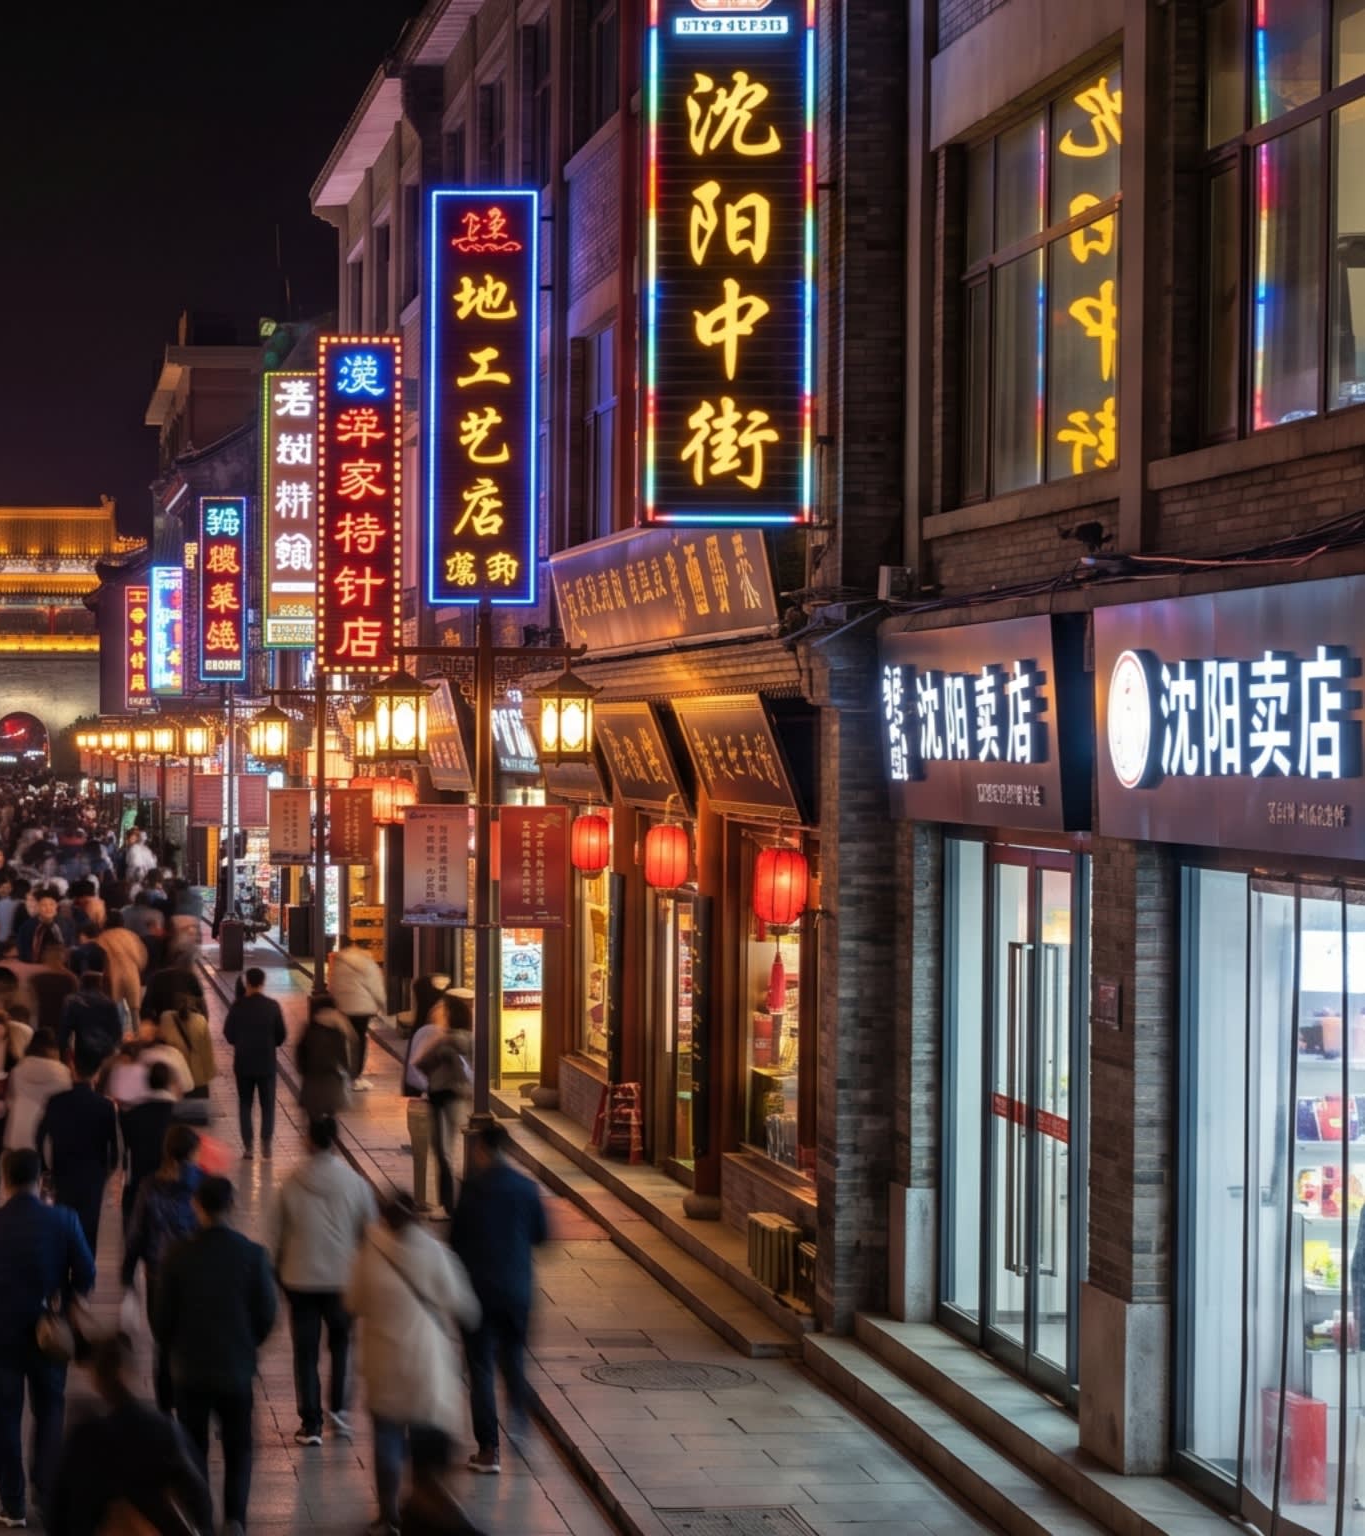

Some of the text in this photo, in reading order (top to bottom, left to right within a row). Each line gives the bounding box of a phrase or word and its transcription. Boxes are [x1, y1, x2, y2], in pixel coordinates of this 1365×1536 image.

[681, 71, 781, 489] 沈阳中街
[916, 661, 1031, 764] 沈阳卖店
[1160, 646, 1342, 779] 沈阳卖店
